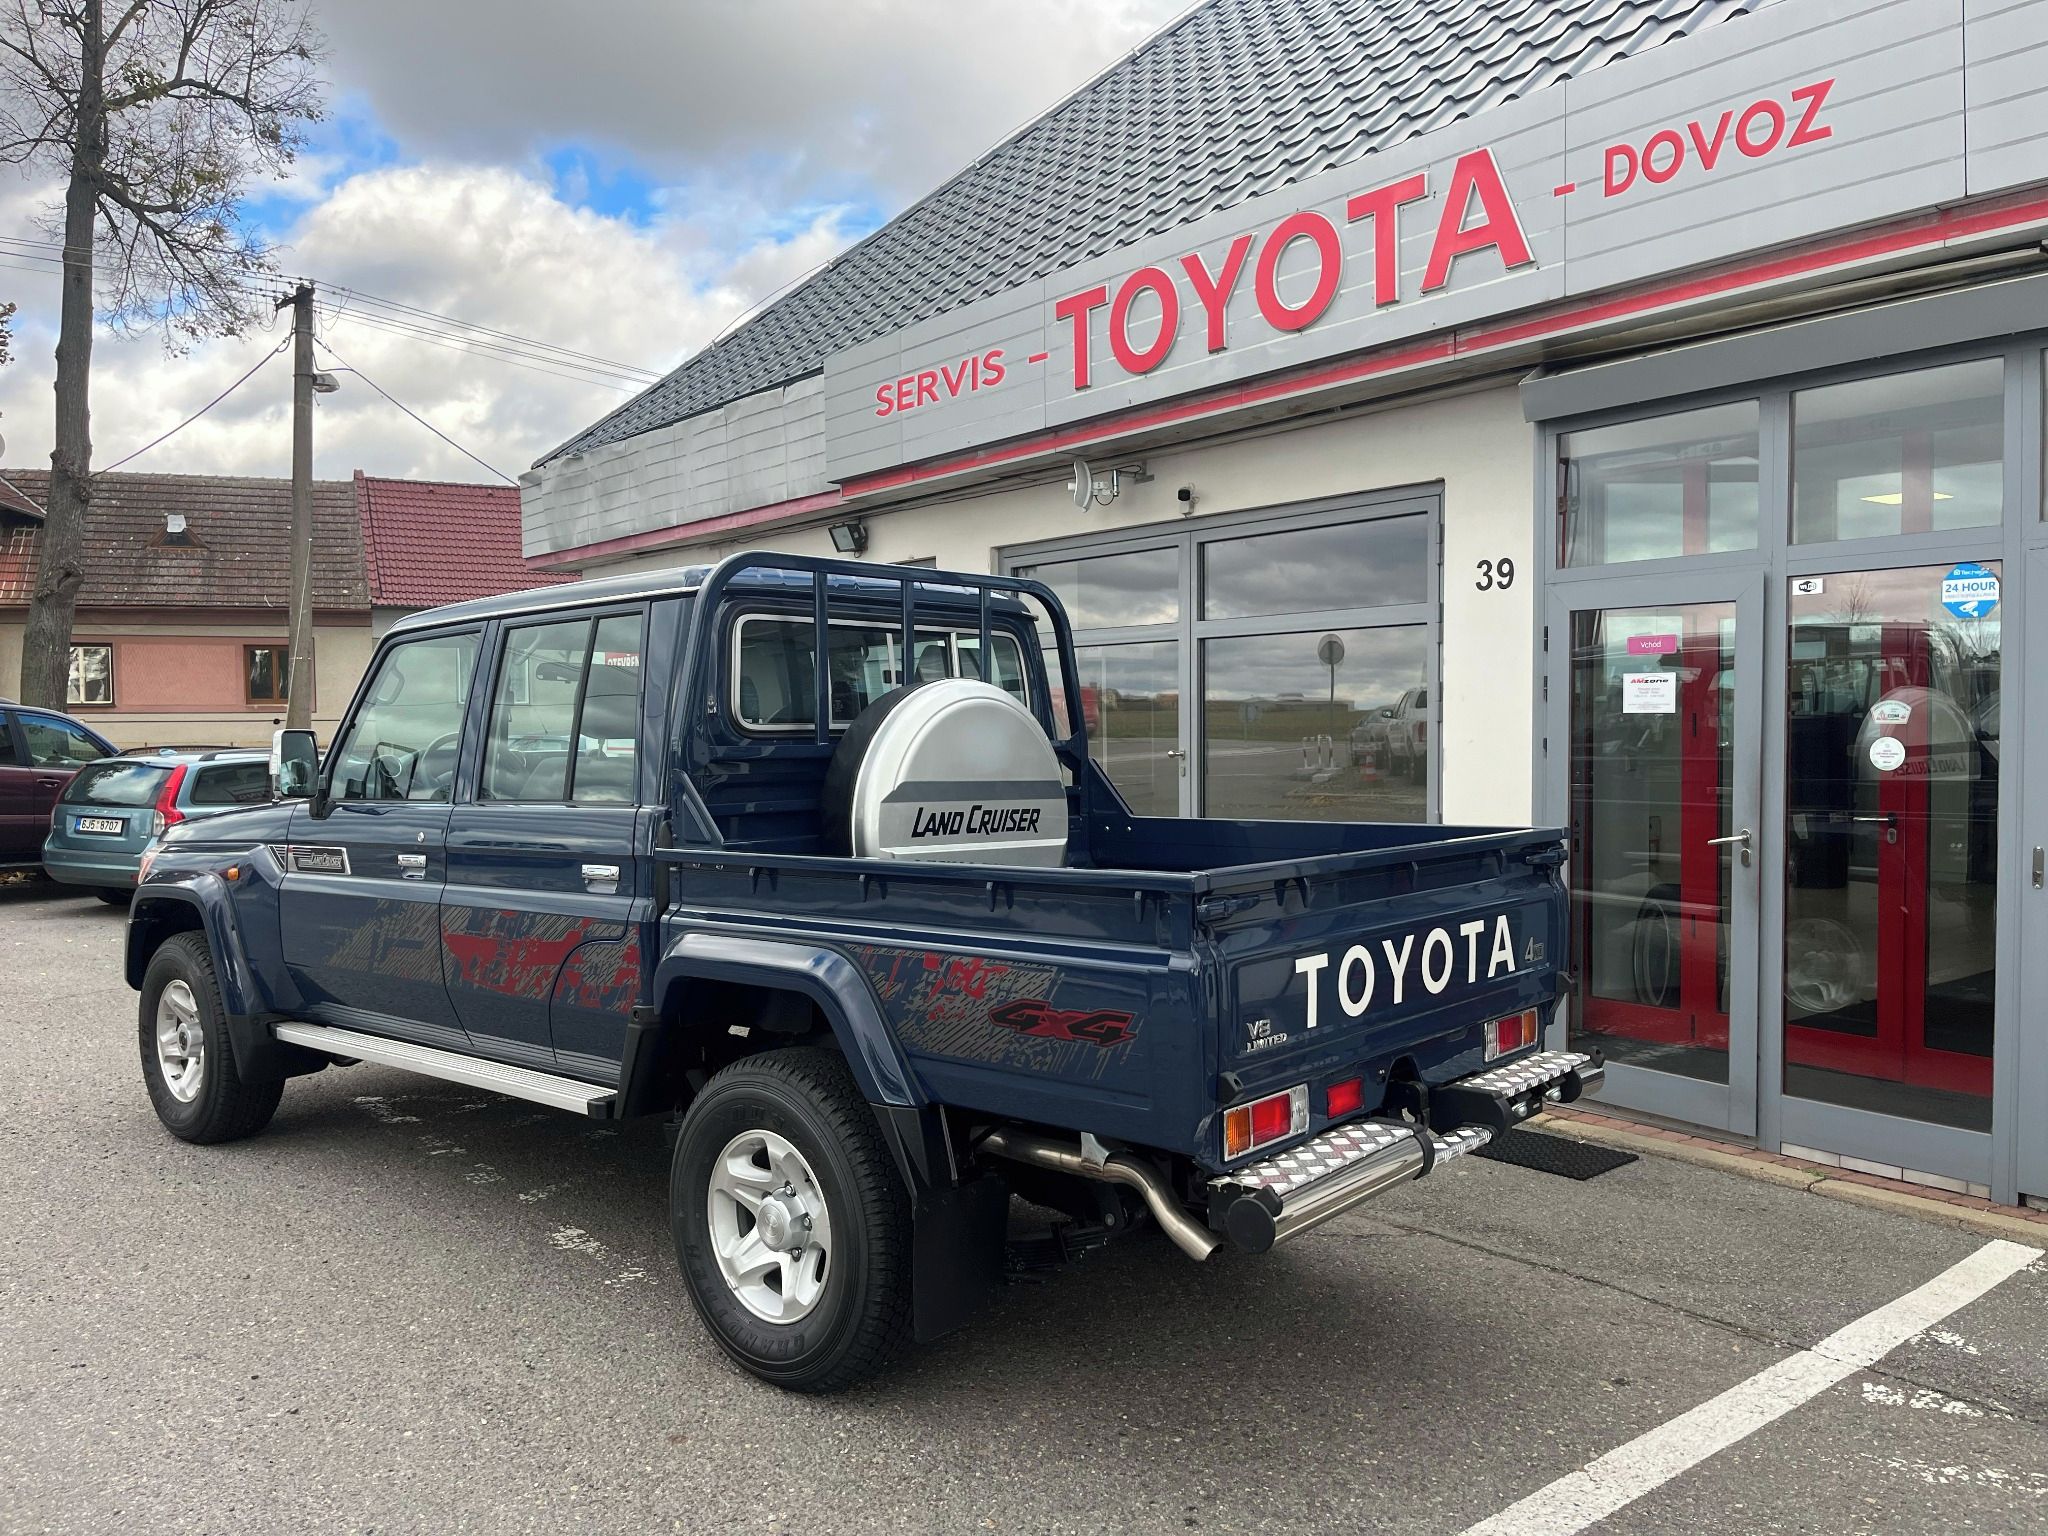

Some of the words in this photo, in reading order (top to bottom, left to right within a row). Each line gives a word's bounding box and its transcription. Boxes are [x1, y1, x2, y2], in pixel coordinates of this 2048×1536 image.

[875, 349, 1006, 417] SERVIS
[1055, 147, 1536, 391] TOYOTA
[1603, 78, 1836, 198] DOVOZ
[1475, 557, 1514, 591] 39
[1945, 584, 1959, 593] 24
[1962, 581, 1996, 592] HOUR
[911, 806, 964, 838] LAND
[966, 804, 1041, 836] CRUISER
[1295, 914, 1516, 1029] TOYOTA
